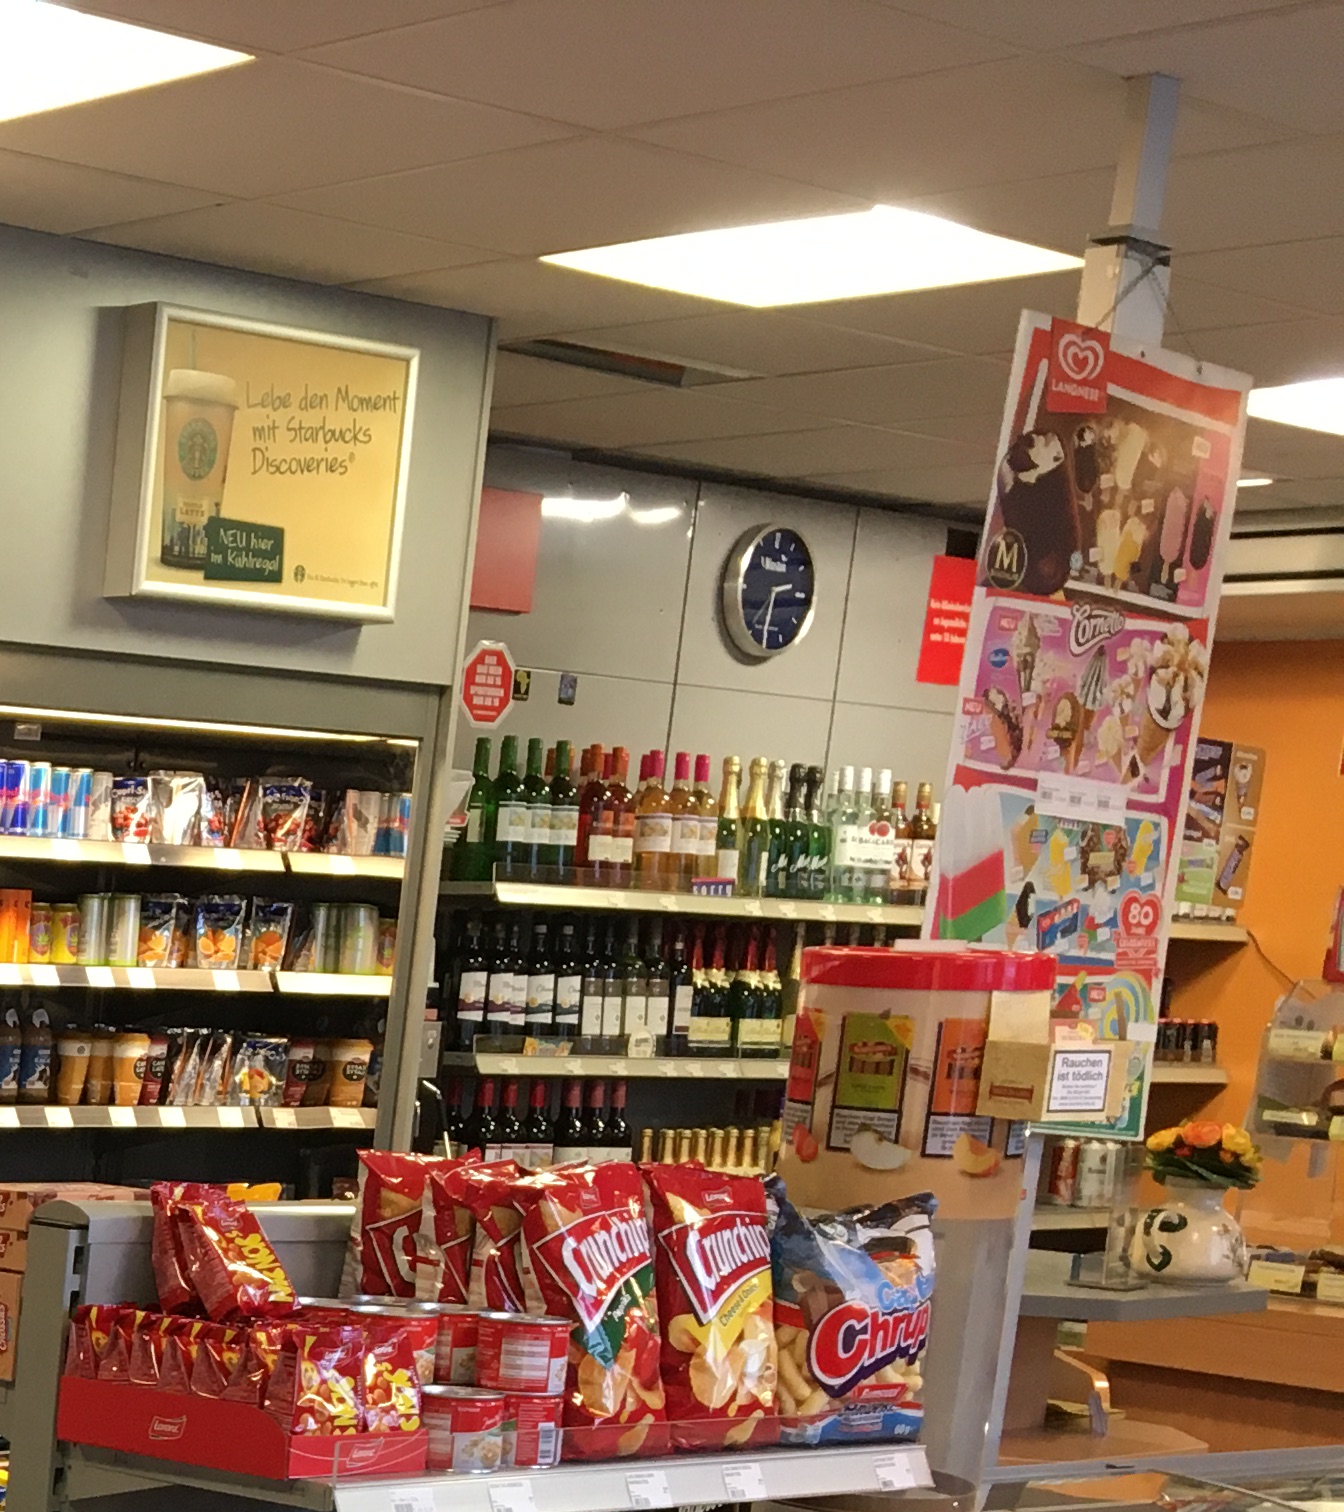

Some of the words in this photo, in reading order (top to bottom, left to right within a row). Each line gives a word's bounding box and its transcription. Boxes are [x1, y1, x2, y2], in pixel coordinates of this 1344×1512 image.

[246, 381, 291, 411] Lebe
[298, 383, 328, 412] den
[335, 384, 400, 414] Moment
[253, 414, 280, 443] mit
[286, 415, 372, 447] Starbucks
[219, 527, 246, 548] NEU
[251, 532, 274, 551] hier
[1128, 903, 1154, 925] 80
[1061, 1056, 1103, 1068] Rauchen
[1057, 1071, 1070, 1082] ist
[1072, 1069, 1104, 1082] tödlich
